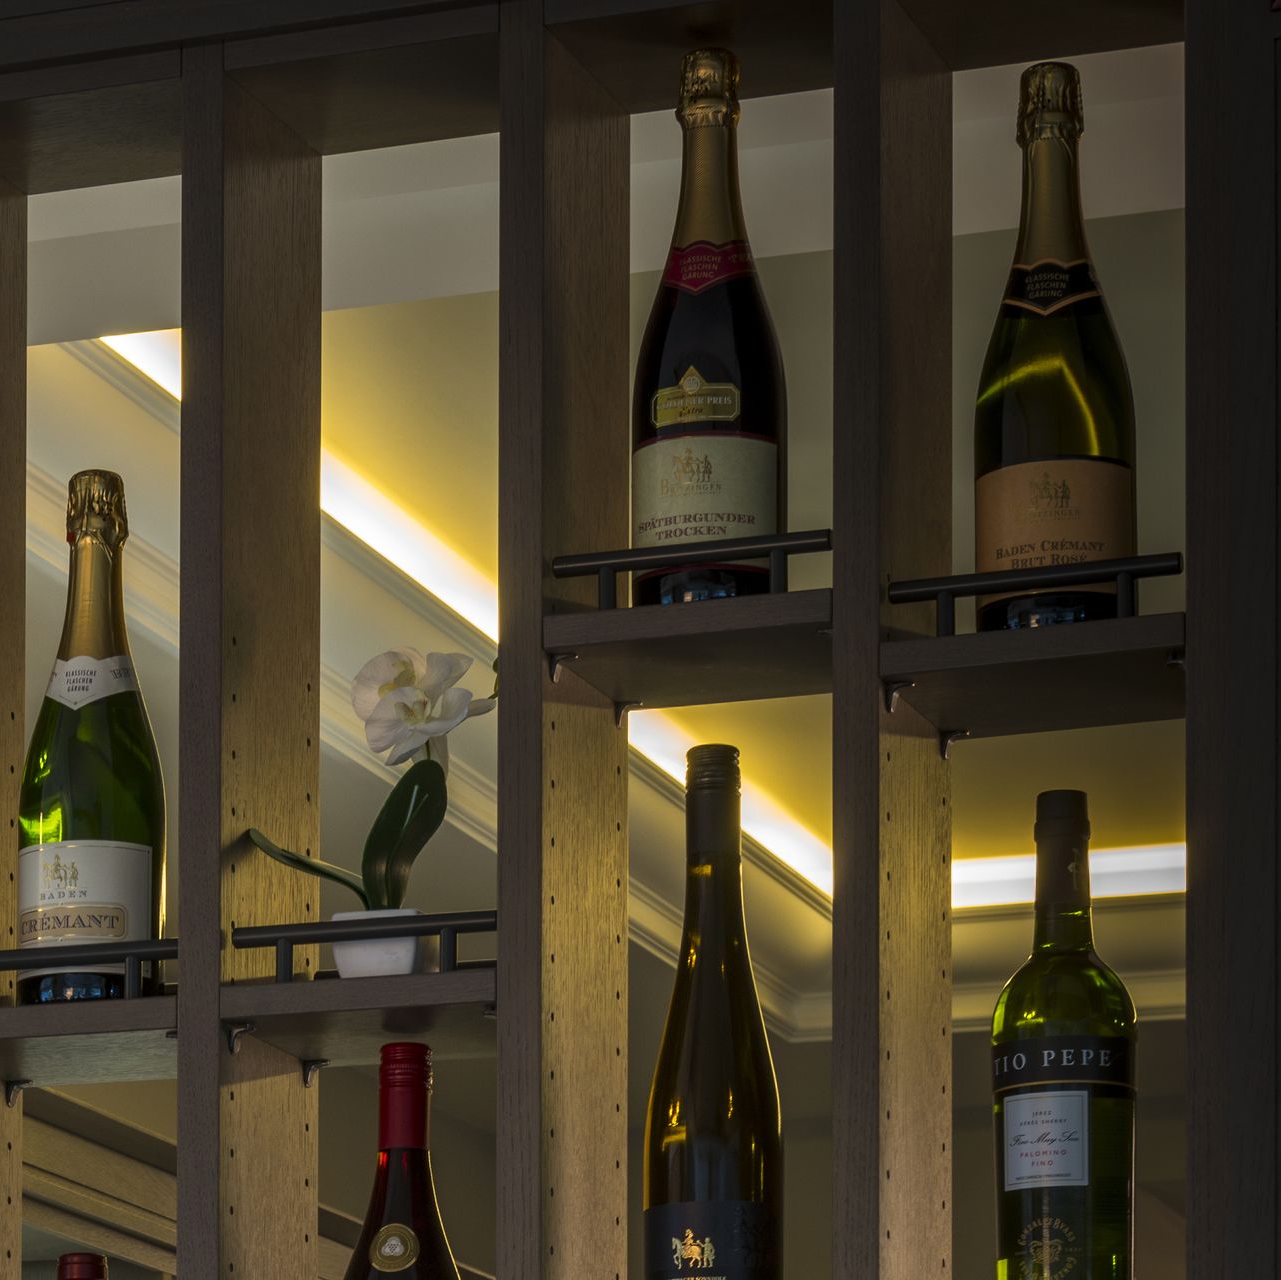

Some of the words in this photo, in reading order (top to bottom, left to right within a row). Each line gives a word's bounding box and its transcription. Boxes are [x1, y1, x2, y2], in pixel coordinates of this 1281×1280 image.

[1025, 270, 1069, 284] KLASSISCHE
[1027, 280, 1066, 292] FLASCHEN
[707, 396, 732, 405] PREIS
[638, 511, 756, 535] SPÄTBURGUNDER
[655, 526, 727, 541] TROCKEN
[995, 543, 1036, 561] BADEN
[1041, 538, 1105, 553] CRÉMANT
[1011, 556, 1046, 569] BRUT
[1051, 551, 1086, 566] ROSÉ
[65, 669, 97, 679] KLASSISCHE
[66, 677, 93, 685] FLASCHEN
[39, 889, 88, 900] BADEN
[21, 913, 120, 936] CRÉMANT
[994, 1052, 1026, 1076] TIO
[1041, 1049, 1111, 1069] PEPE
[1020, 1149, 1067, 1159] PALOMINO
[1031, 1159, 1053, 1168] FINO
